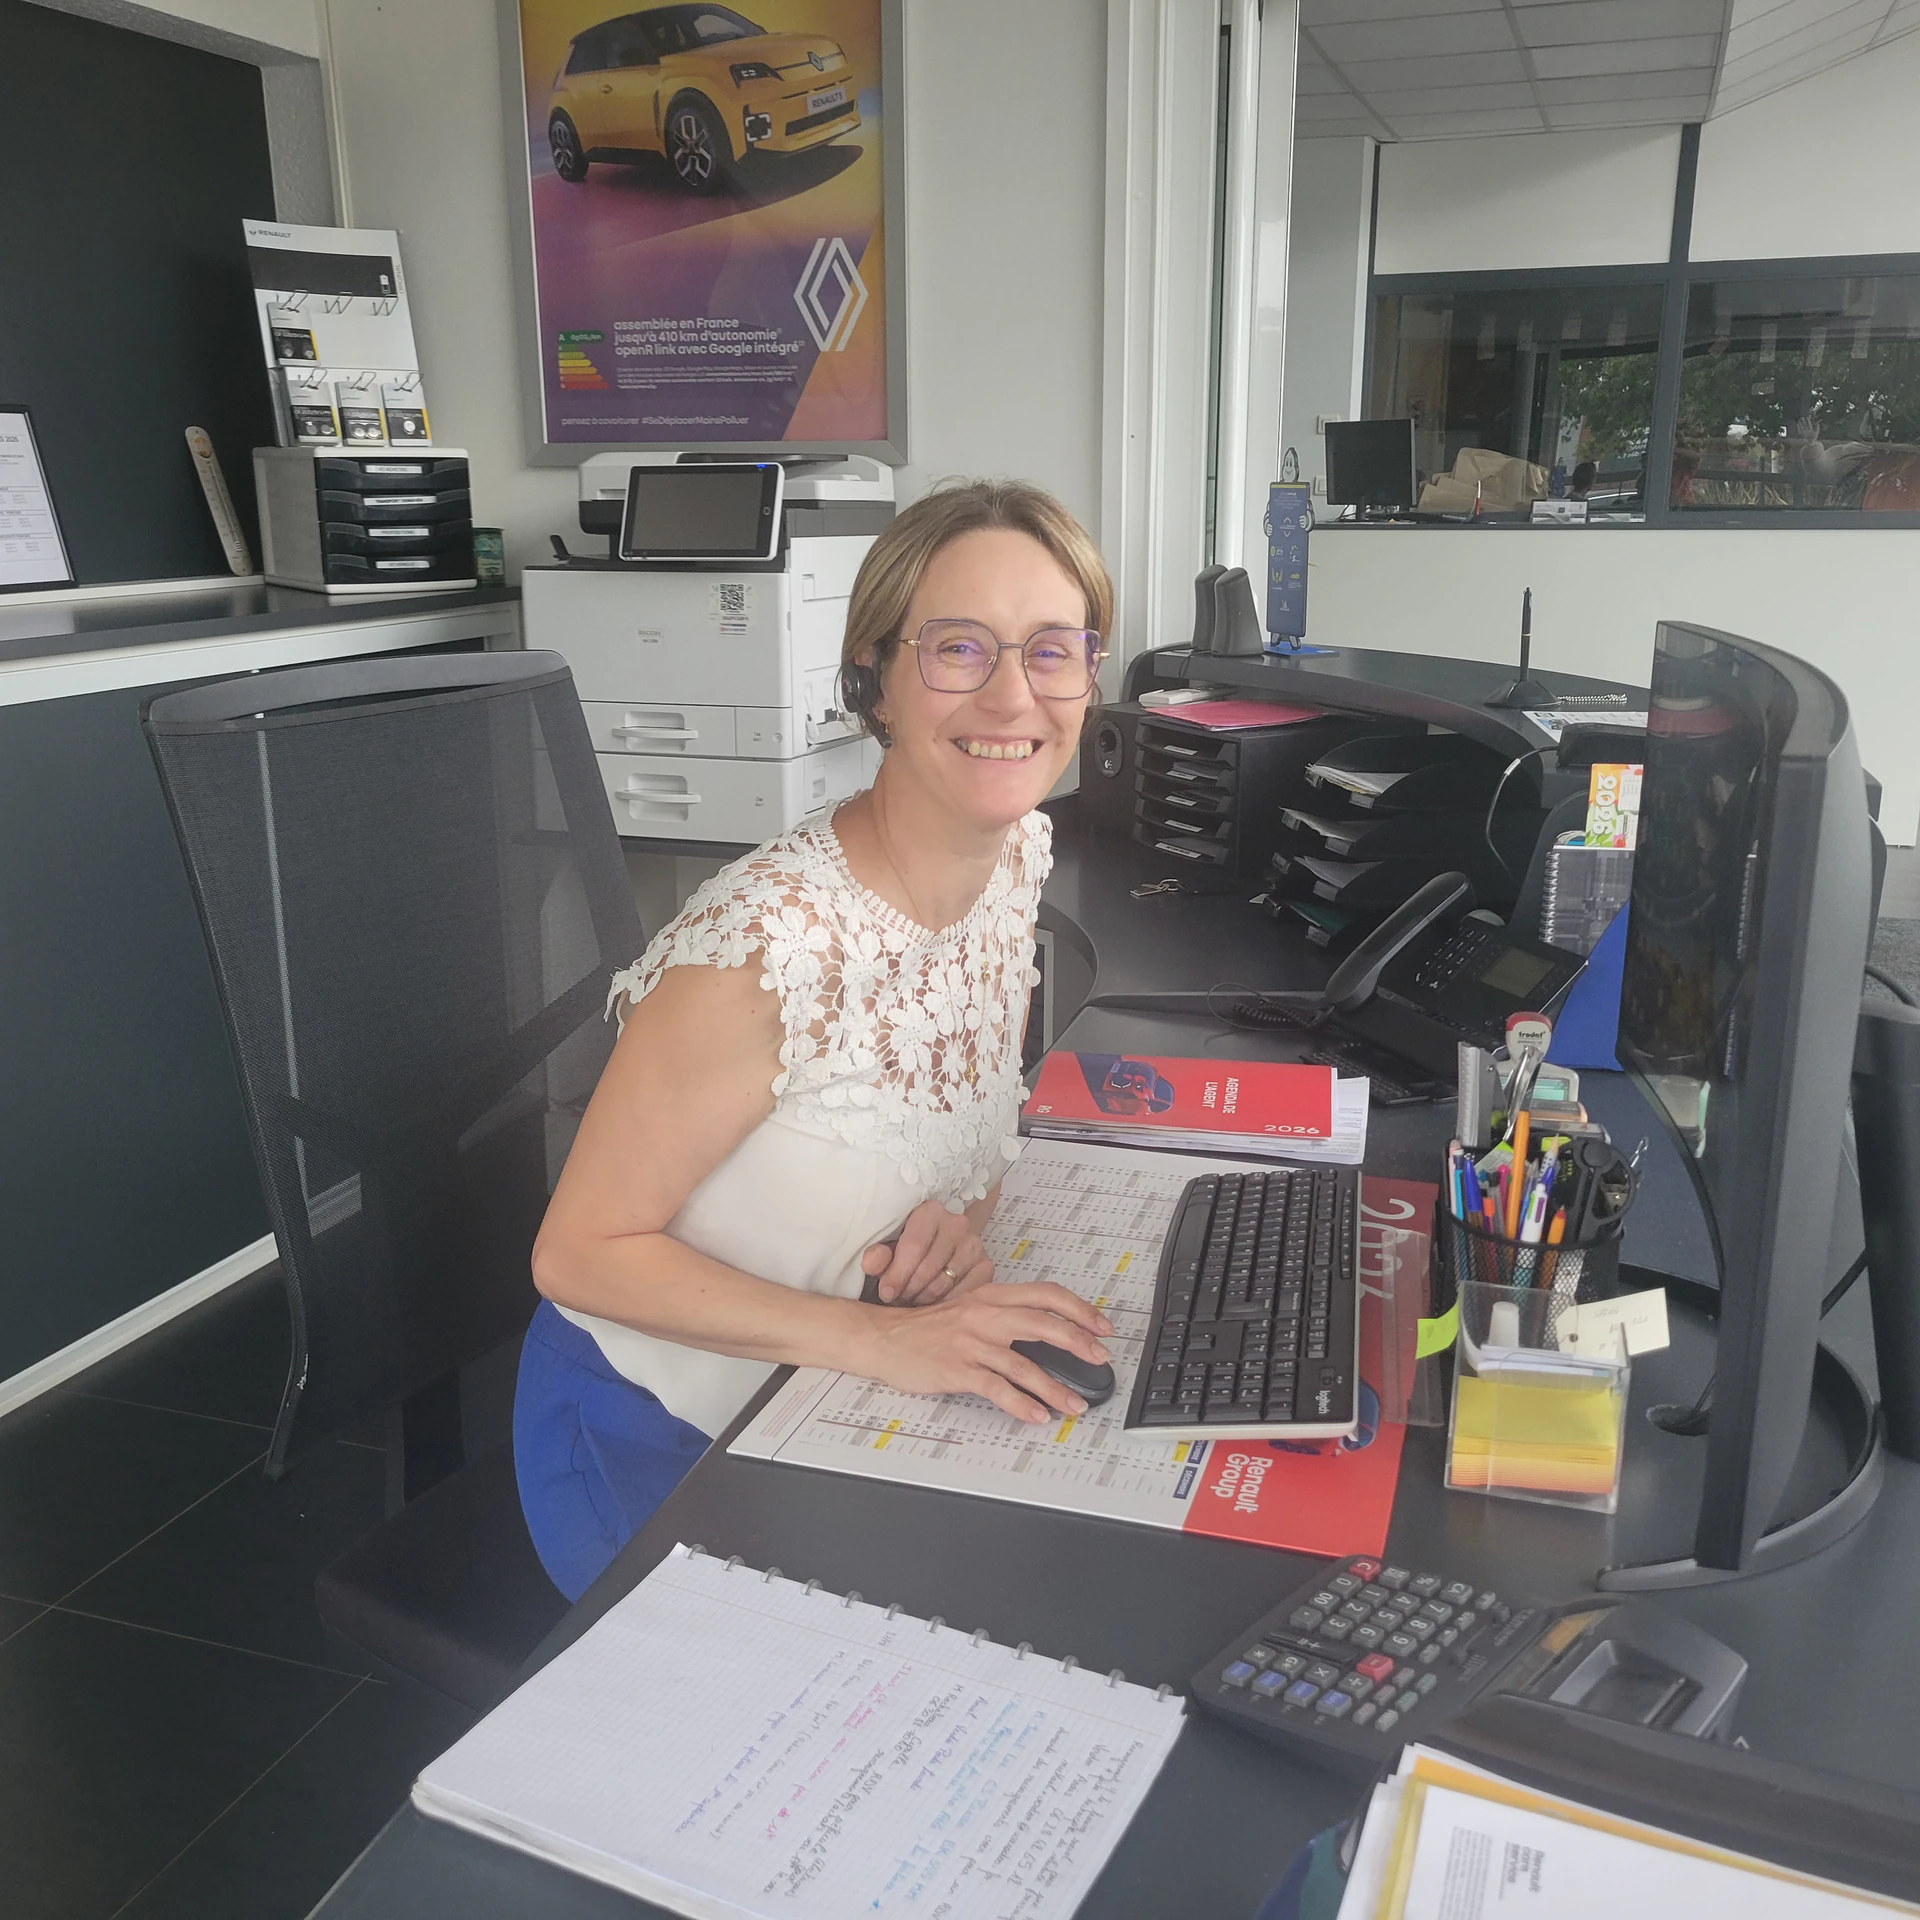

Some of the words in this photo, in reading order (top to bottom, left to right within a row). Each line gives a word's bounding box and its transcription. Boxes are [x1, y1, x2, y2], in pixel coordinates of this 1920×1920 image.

[258, 229, 292, 238] RENAULT
[614, 318, 678, 330] assemblée
[679, 320, 695, 329] en
[696, 318, 740, 329] France
[614, 331, 657, 346] jusqu'à
[658, 331, 679, 342] 410
[680, 330, 699, 342] km
[615, 344, 654, 358] openR
[654, 344, 676, 355] link
[678, 344, 708, 354] avec
[708, 342, 752, 356] Google
[1592, 772, 1618, 836] 2026
[1202, 1081, 1218, 1109] L'AGENT
[1226, 1076, 1240, 1102] AGENDA
[1222, 1102, 1236, 1114] DE
[1264, 1124, 1320, 1135] 2026
[1315, 1390, 1330, 1414] logitech
[1210, 1453, 1250, 1498] Group
[1234, 1456, 1274, 1514] Renault
[1356, 1562, 1372, 1570] C
[1336, 1578, 1352, 1586] 0
[1314, 1592, 1334, 1605] 00
[1396, 1596, 1412, 1605] 4
[1348, 1602, 1364, 1612] 2
[1429, 1604, 1444, 1613] 7
[1378, 1610, 1396, 1620] 5
[1329, 1618, 1346, 1628] 3
[1410, 1620, 1428, 1630] 8
[1360, 1627, 1376, 1638] 6
[1392, 1635, 1408, 1645] 9
[860, 1771, 883, 1795] RDV
[935, 1901, 952, 1920] RDV
